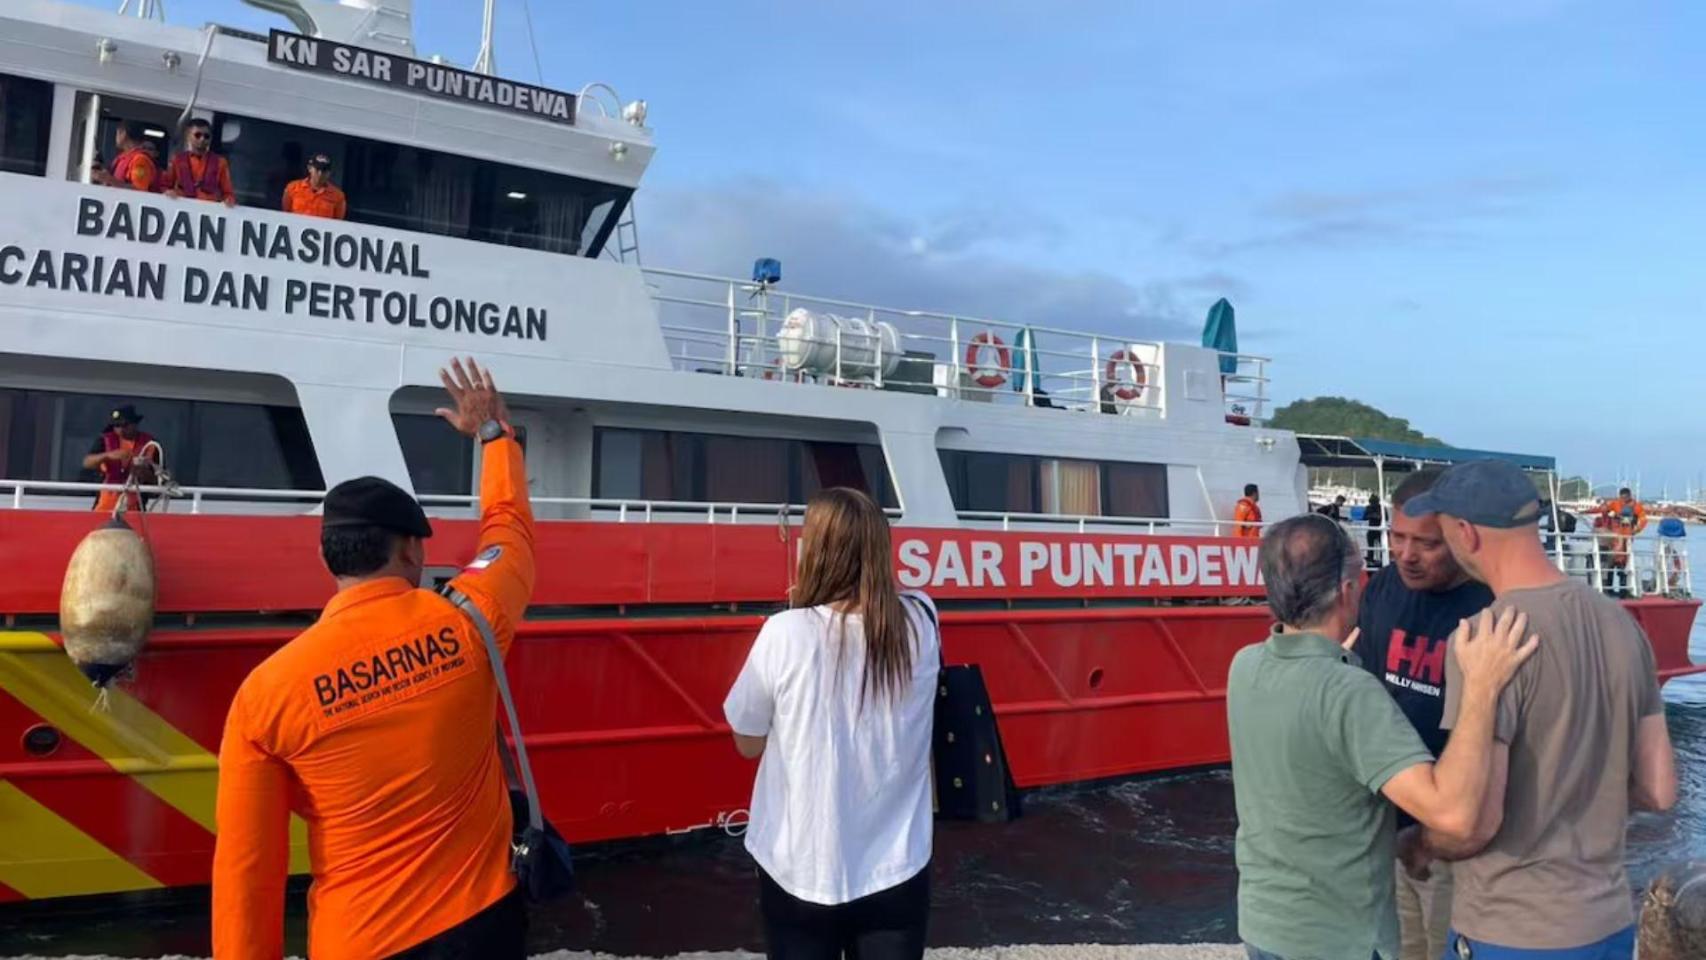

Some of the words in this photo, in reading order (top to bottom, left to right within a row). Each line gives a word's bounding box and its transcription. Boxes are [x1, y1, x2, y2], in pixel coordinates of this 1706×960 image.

[275, 34, 318, 66] KN
[333, 46, 392, 81] SAR
[407, 63, 569, 119] PUNTADEWA
[76, 197, 226, 252] BADAN
[240, 220, 430, 278] NASIONAL
[0, 245, 167, 300] CARIAN
[183, 266, 269, 311] DAN
[285, 279, 548, 341] PERTOLONGAN
[898, 538, 1006, 588] SAR
[1019, 540, 1265, 587] PUNTADEW
[314, 627, 460, 707] BASARNAS
